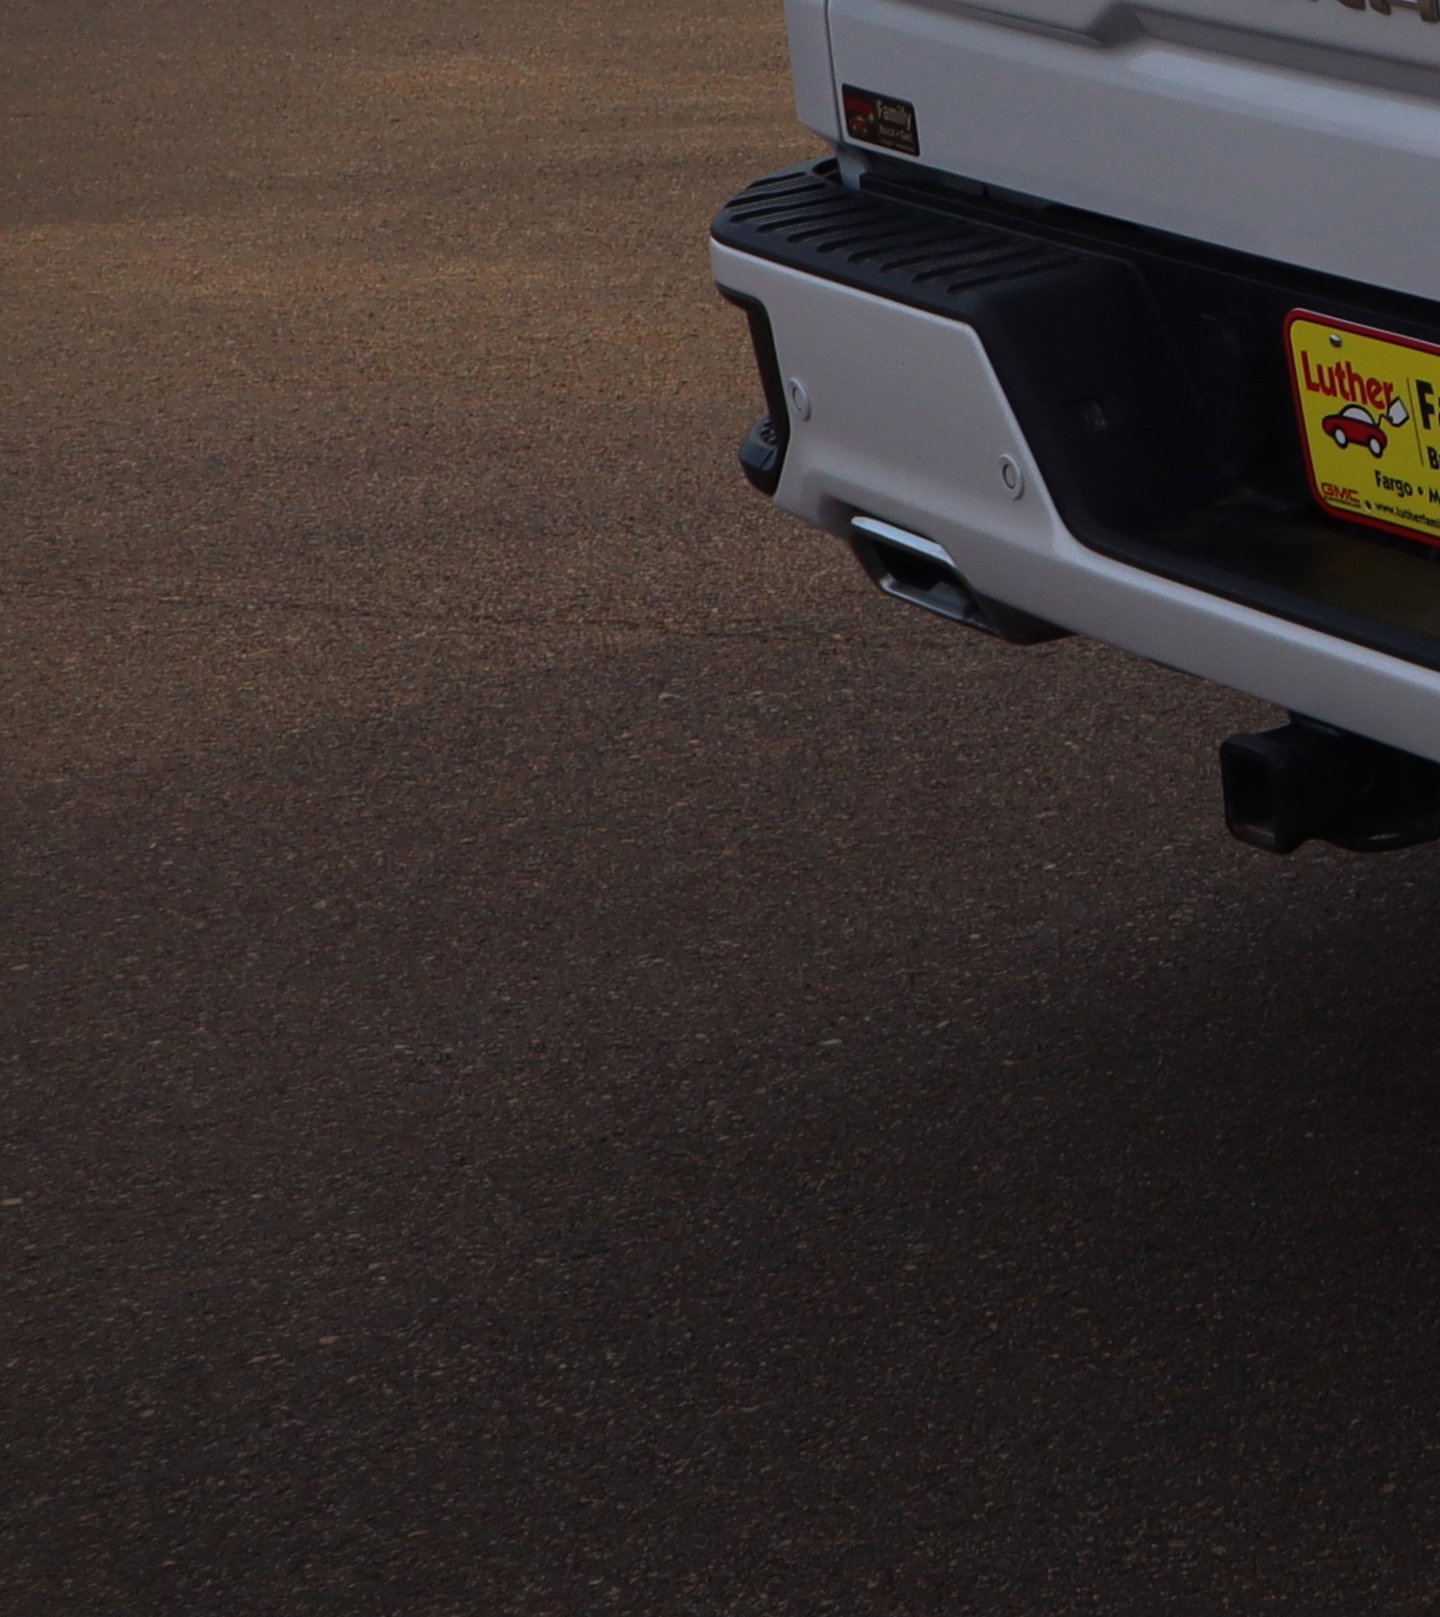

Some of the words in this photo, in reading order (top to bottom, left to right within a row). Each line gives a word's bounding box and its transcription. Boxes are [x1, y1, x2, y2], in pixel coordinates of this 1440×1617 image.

[877, 99, 912, 132] Family
[1300, 350, 1395, 410] Luther
[1321, 482, 1361, 504] GMC
[1374, 469, 1413, 497] Fargo
